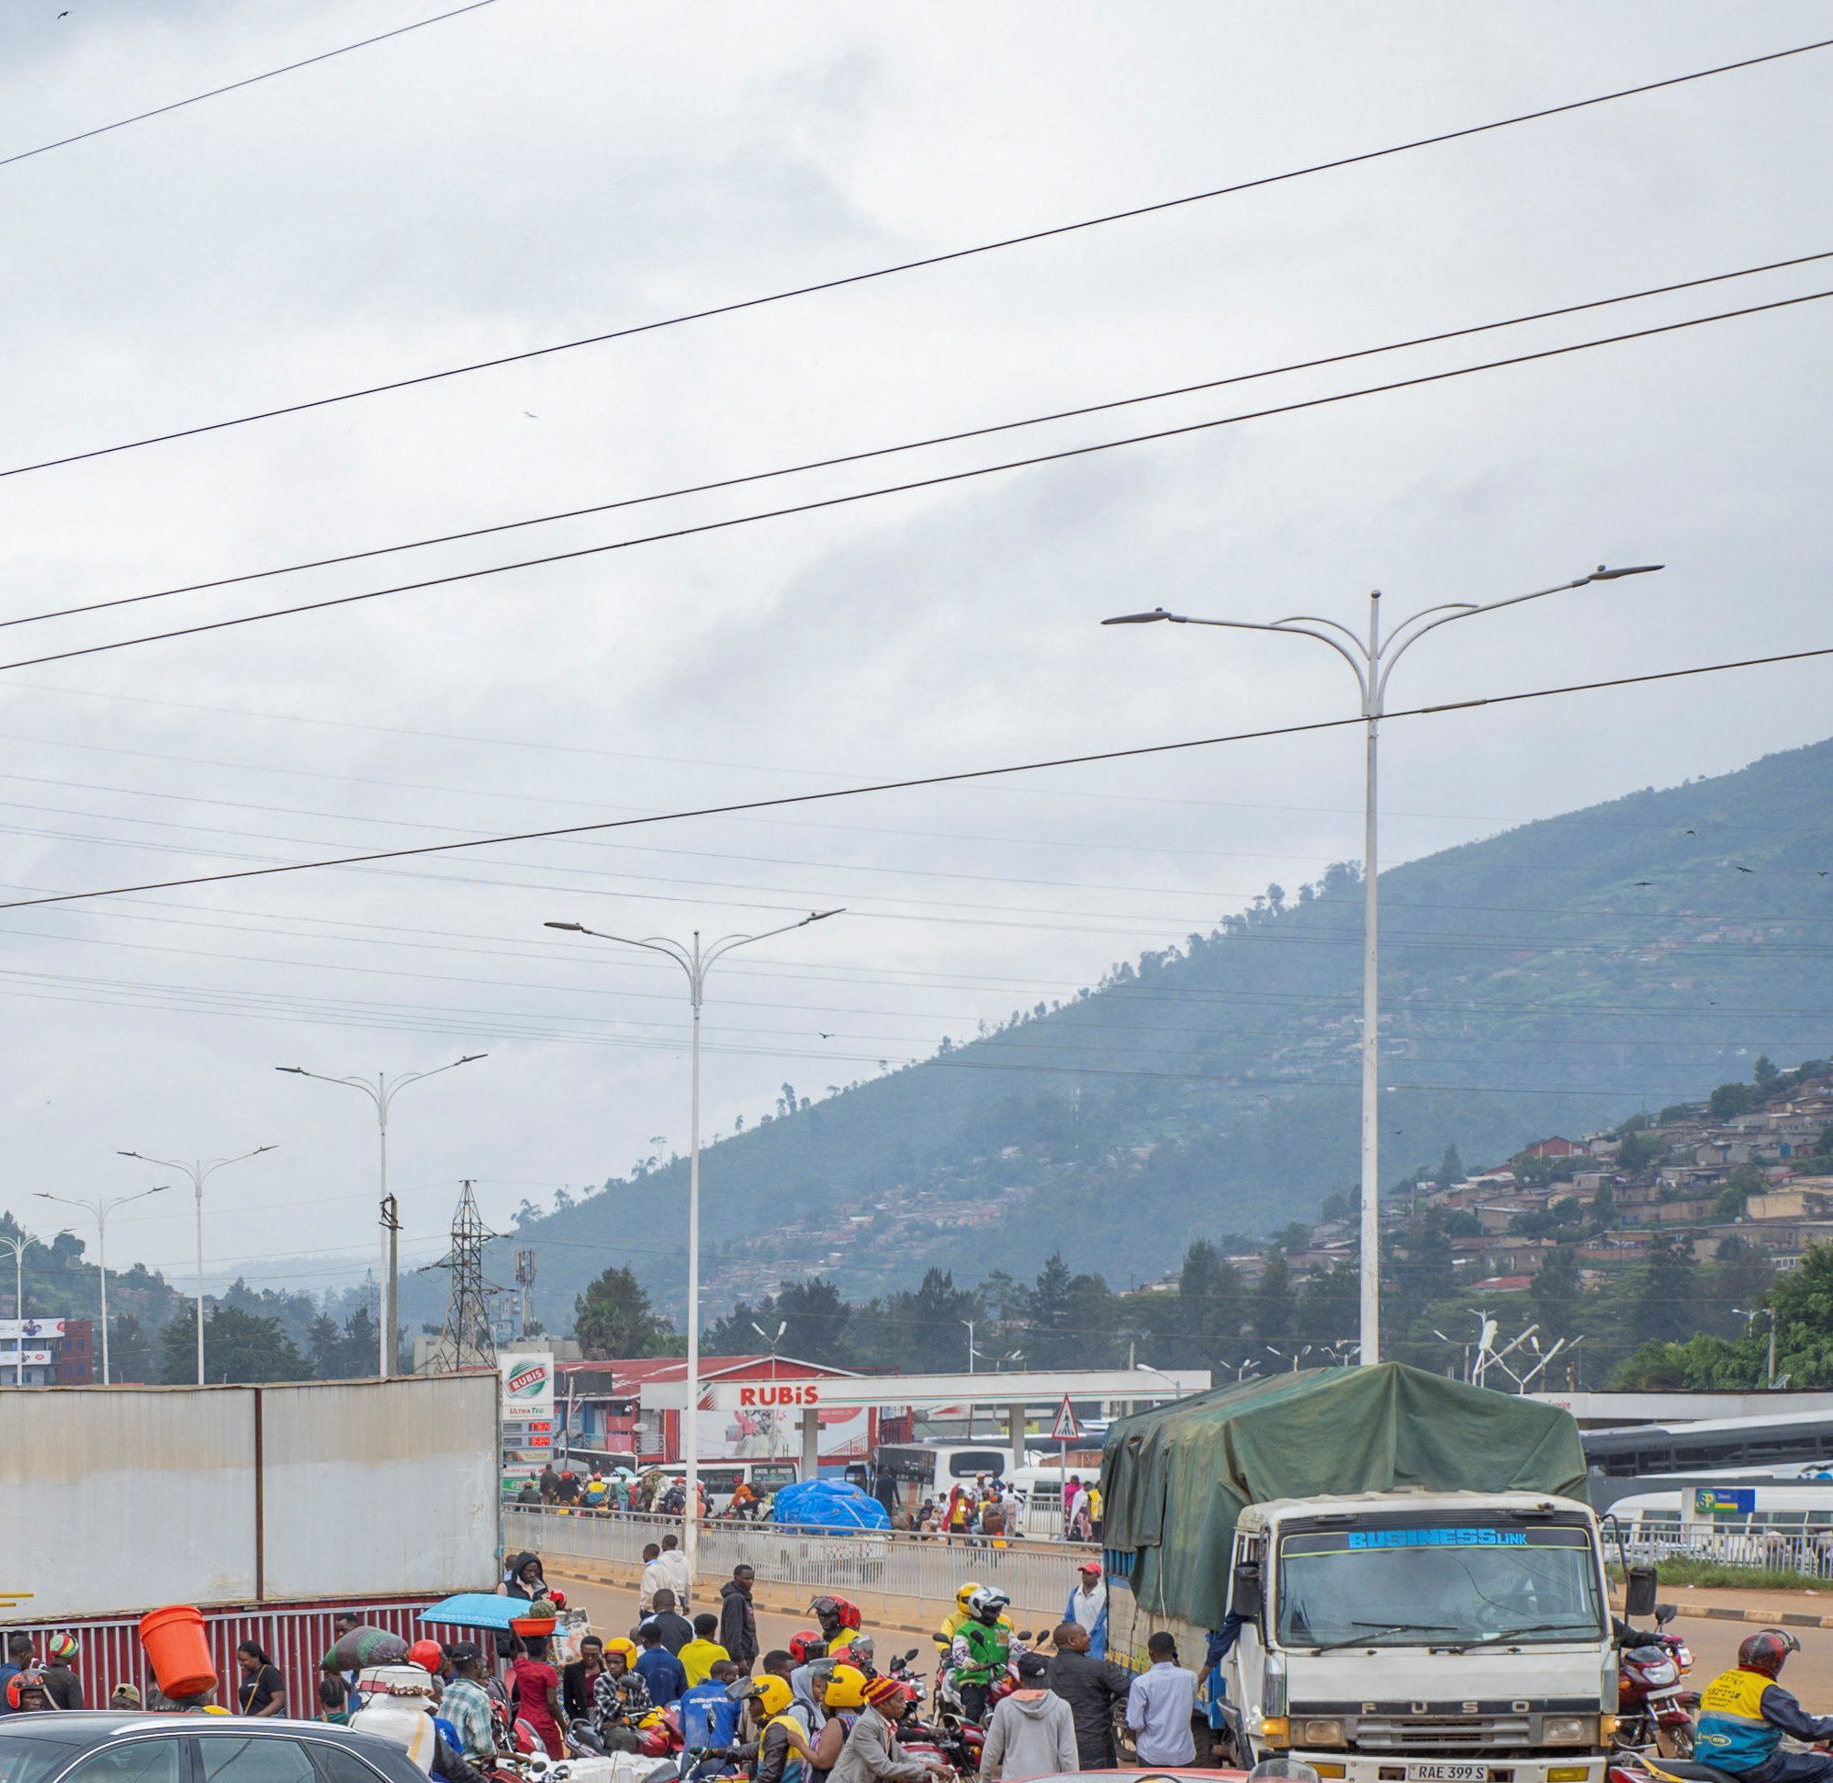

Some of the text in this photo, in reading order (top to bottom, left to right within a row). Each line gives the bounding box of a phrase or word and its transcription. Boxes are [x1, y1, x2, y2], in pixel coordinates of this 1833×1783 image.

[511, 1368, 543, 1390] RUBIS
[1348, 1528, 1496, 1549] BUSINESS
[1361, 1699, 1530, 1715] FUSO
[1418, 1765, 1485, 1779] RAE 399 S
